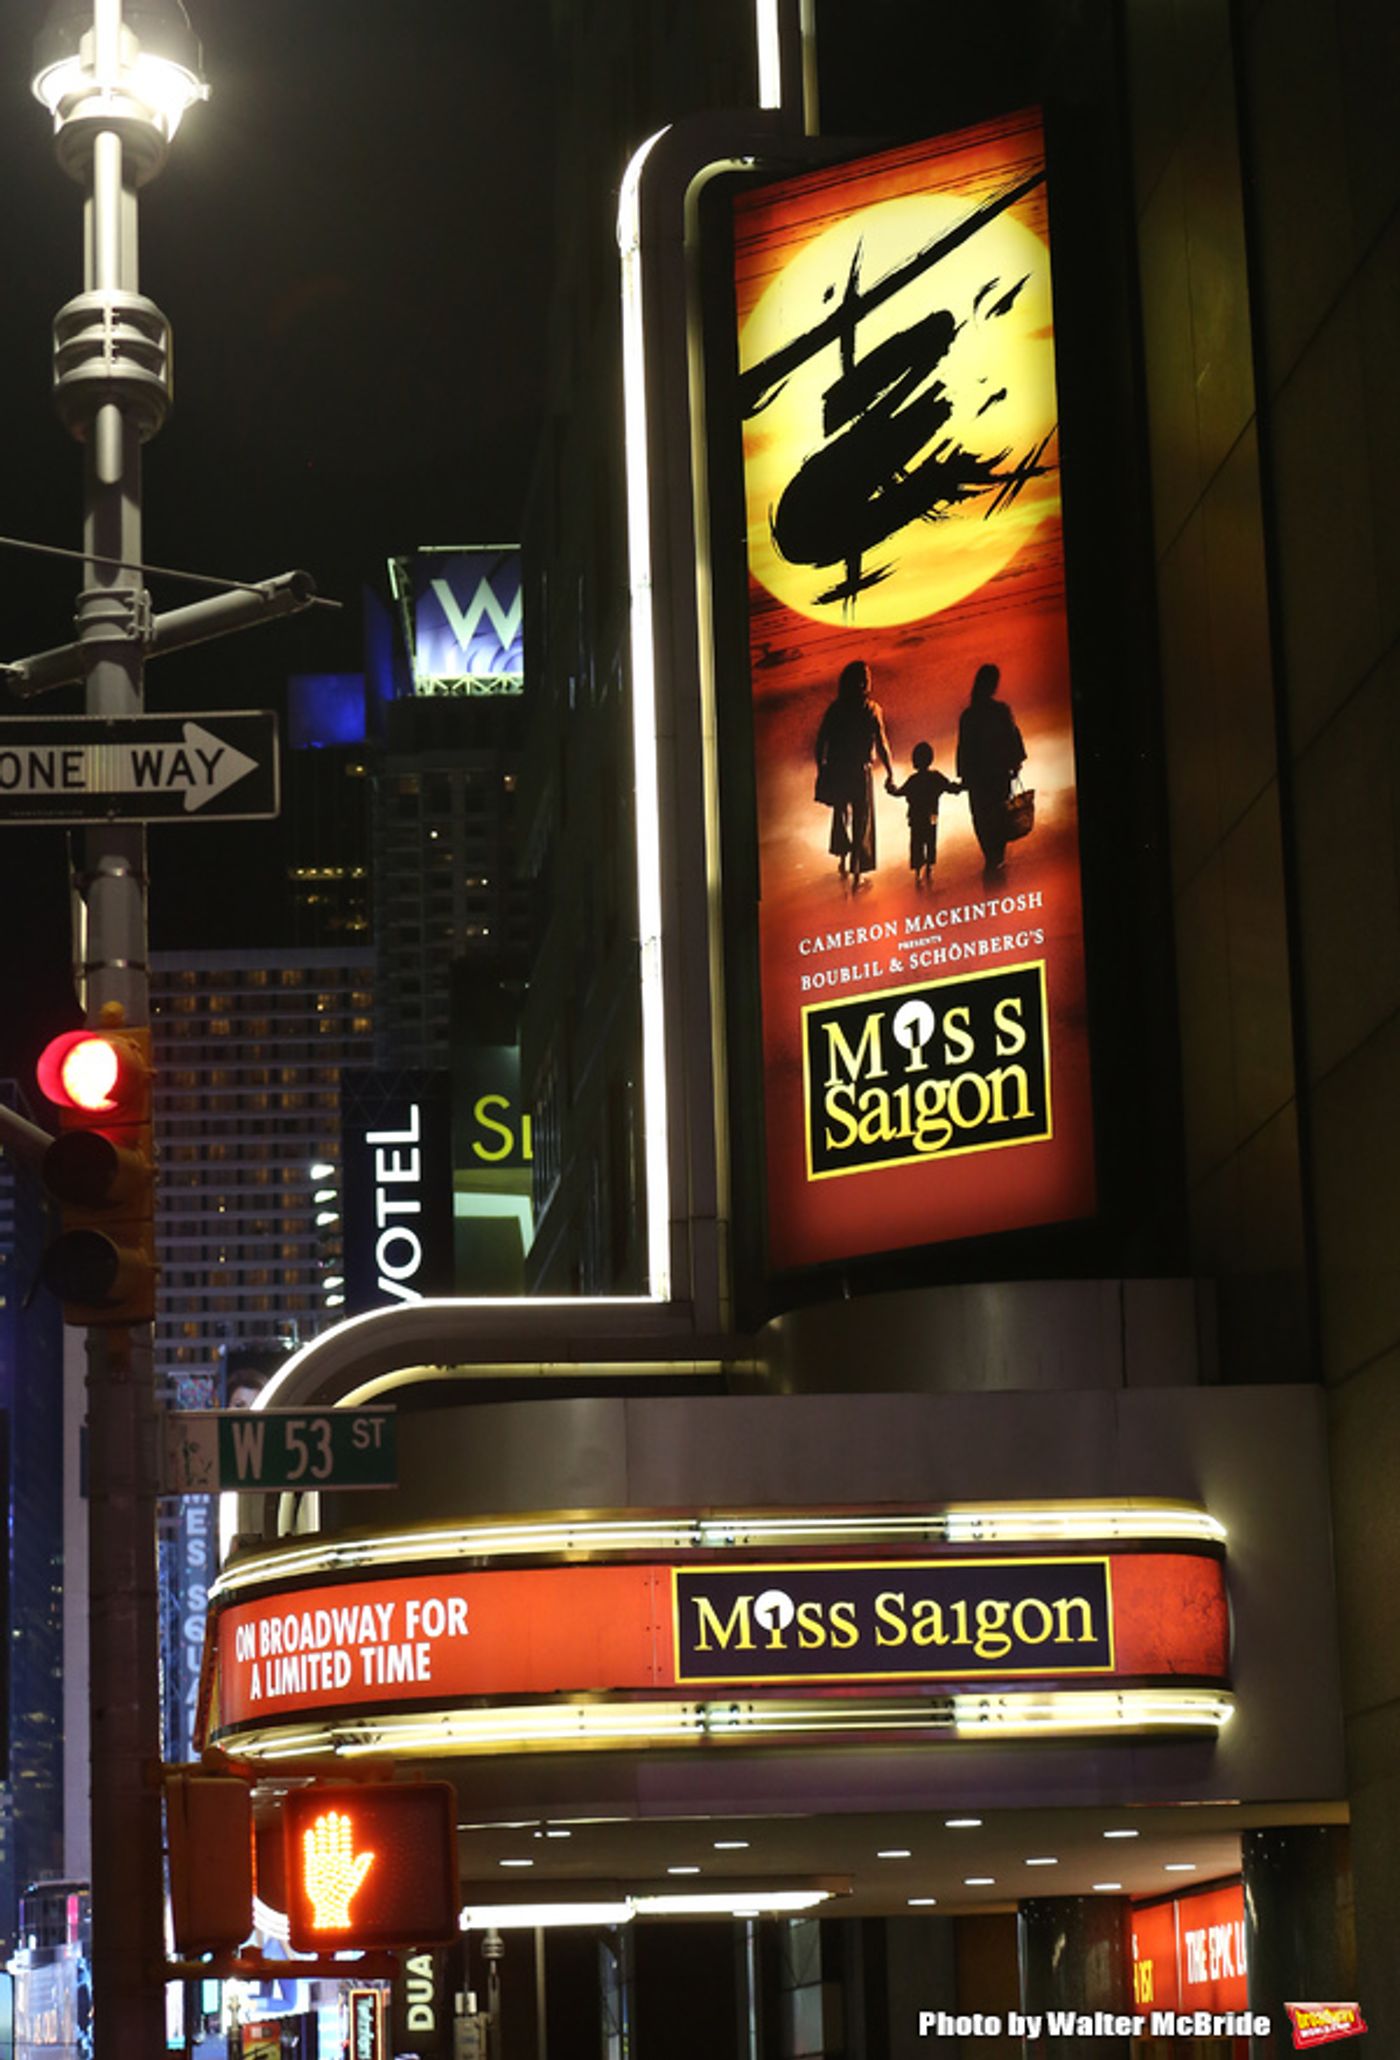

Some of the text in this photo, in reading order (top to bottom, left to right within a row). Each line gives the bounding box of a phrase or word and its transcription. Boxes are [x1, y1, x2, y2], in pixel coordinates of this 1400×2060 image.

[430, 576, 523, 652] W
[0, 748, 225, 789] ONE WAY
[799, 891, 1044, 956] CAMERON MACKINTOSH
[800, 928, 1046, 991] BOUBLIL & SCHÖNBERG'S
[824, 1062, 1035, 1152] Saigon
[232, 1417, 386, 1480] W 53 ST
[235, 1597, 469, 1663] ON BROADWAY FOR
[874, 1591, 1097, 1660] Saigon
[250, 1642, 431, 1701] A LIMITED TIME
[1184, 1928, 1208, 1985] THE
[1208, 1921, 1235, 1981] EPIC
[406, 1948, 436, 2031] DUA
